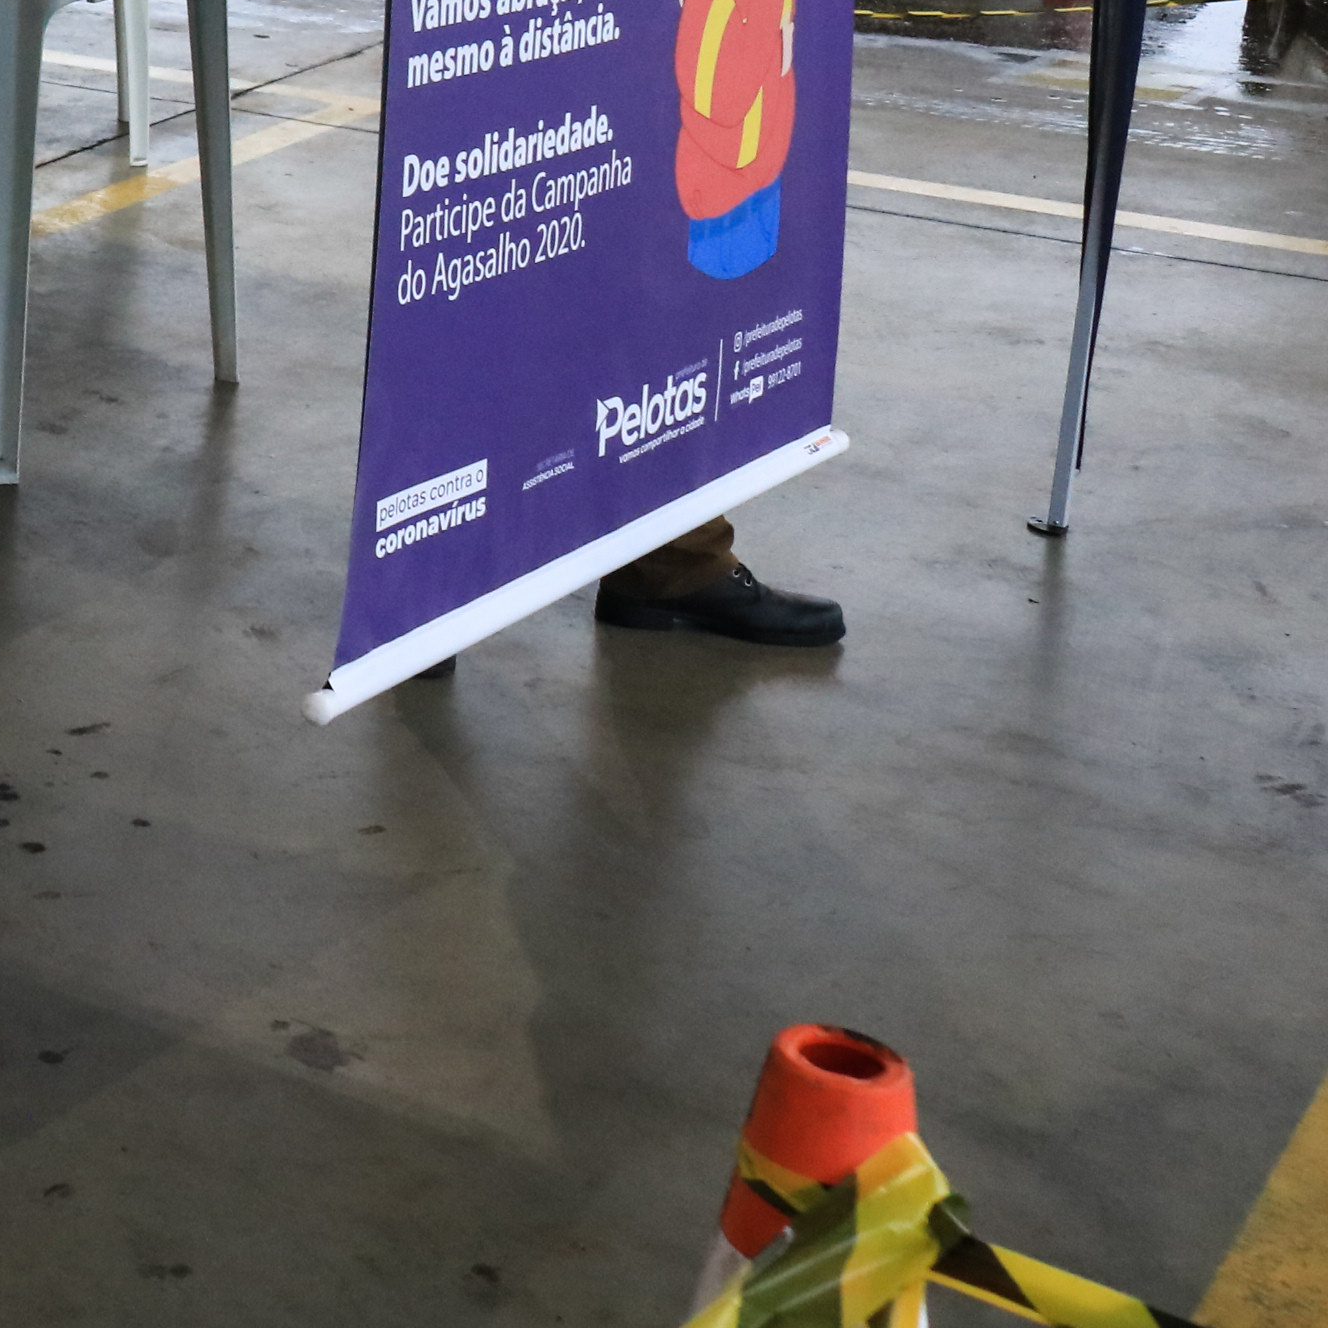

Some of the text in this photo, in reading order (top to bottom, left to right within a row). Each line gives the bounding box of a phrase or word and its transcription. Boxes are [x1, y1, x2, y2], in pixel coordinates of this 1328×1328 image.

[407, 3, 621, 88] mesmo à distância.
[402, 104, 614, 198] Doe solidariedade.
[400, 149, 633, 253] Participe da Campanha
[397, 212, 586, 306] do Agasalho 2020.
[596, 372, 708, 458] Pelotas
[618, 449, 641, 464] vamos
[640, 429, 680, 454] compartilhar
[686, 415, 706, 434] cidade
[375, 497, 486, 559] coronavírus
[379, 469, 484, 528] pelotas contra o
